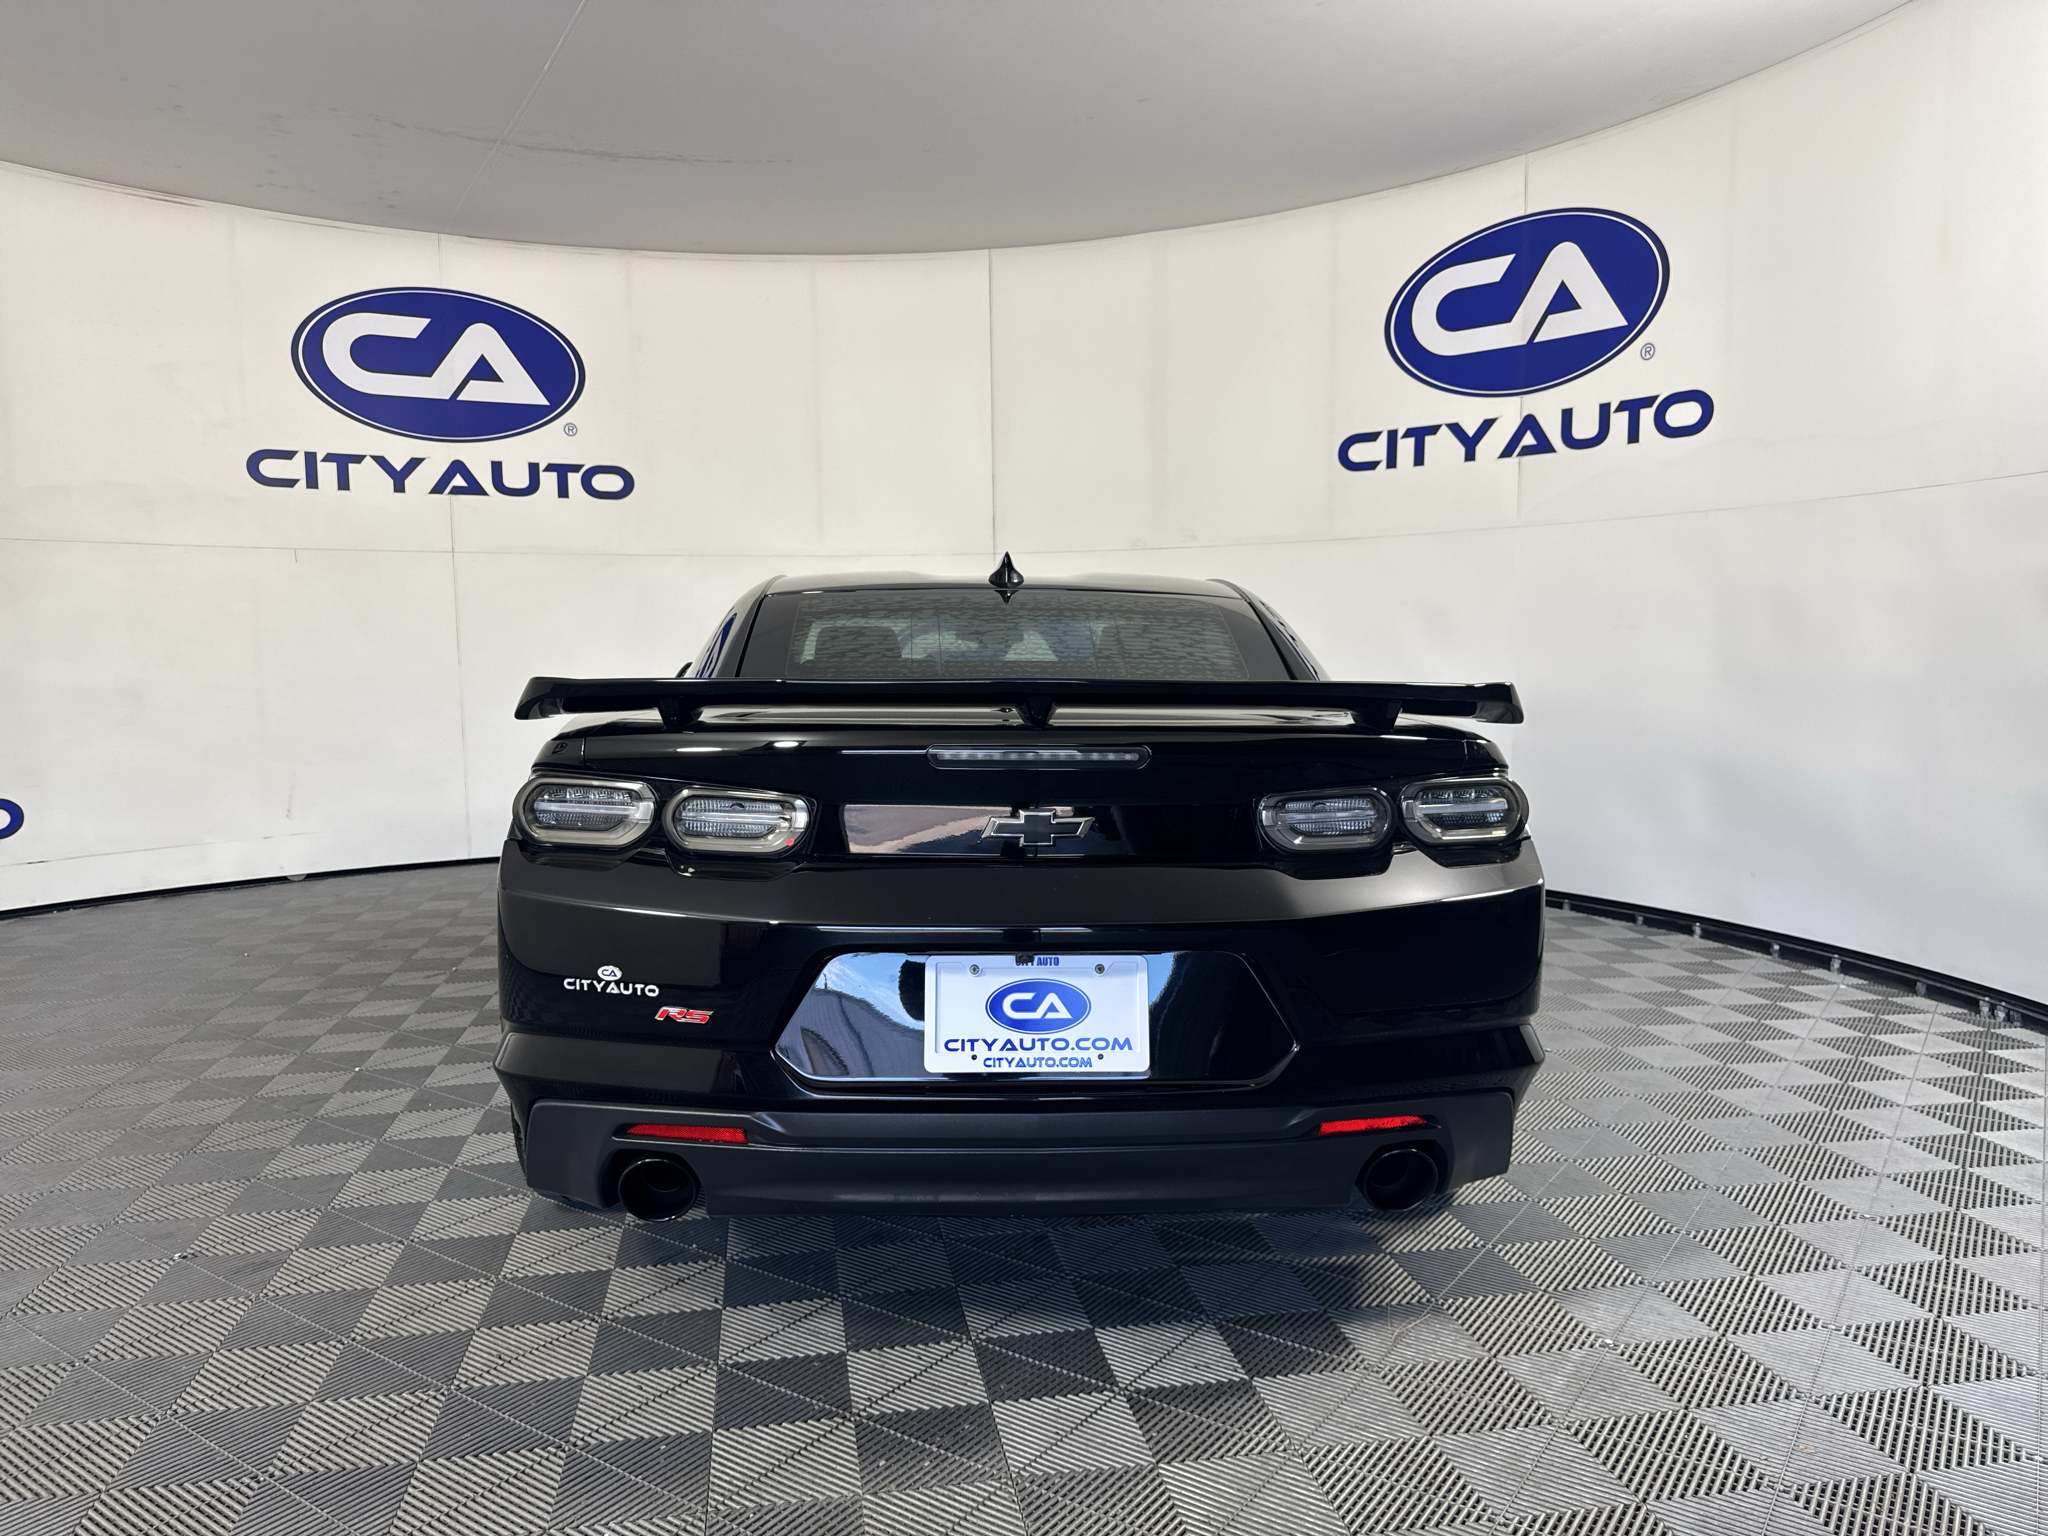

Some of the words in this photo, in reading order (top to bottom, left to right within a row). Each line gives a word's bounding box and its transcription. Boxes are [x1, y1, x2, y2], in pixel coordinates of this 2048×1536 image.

[1410, 240, 1629, 357] CA
[321, 311, 551, 406] CA
[1036, 956, 1060, 967] AUTO
[601, 968, 618, 978] CA
[1002, 992, 1073, 1019] CA
[654, 1005, 715, 1024] RS
[943, 1037, 1133, 1052] CITYAUTO.COM
[983, 1056, 1093, 1068] CITYAUTO.COM
